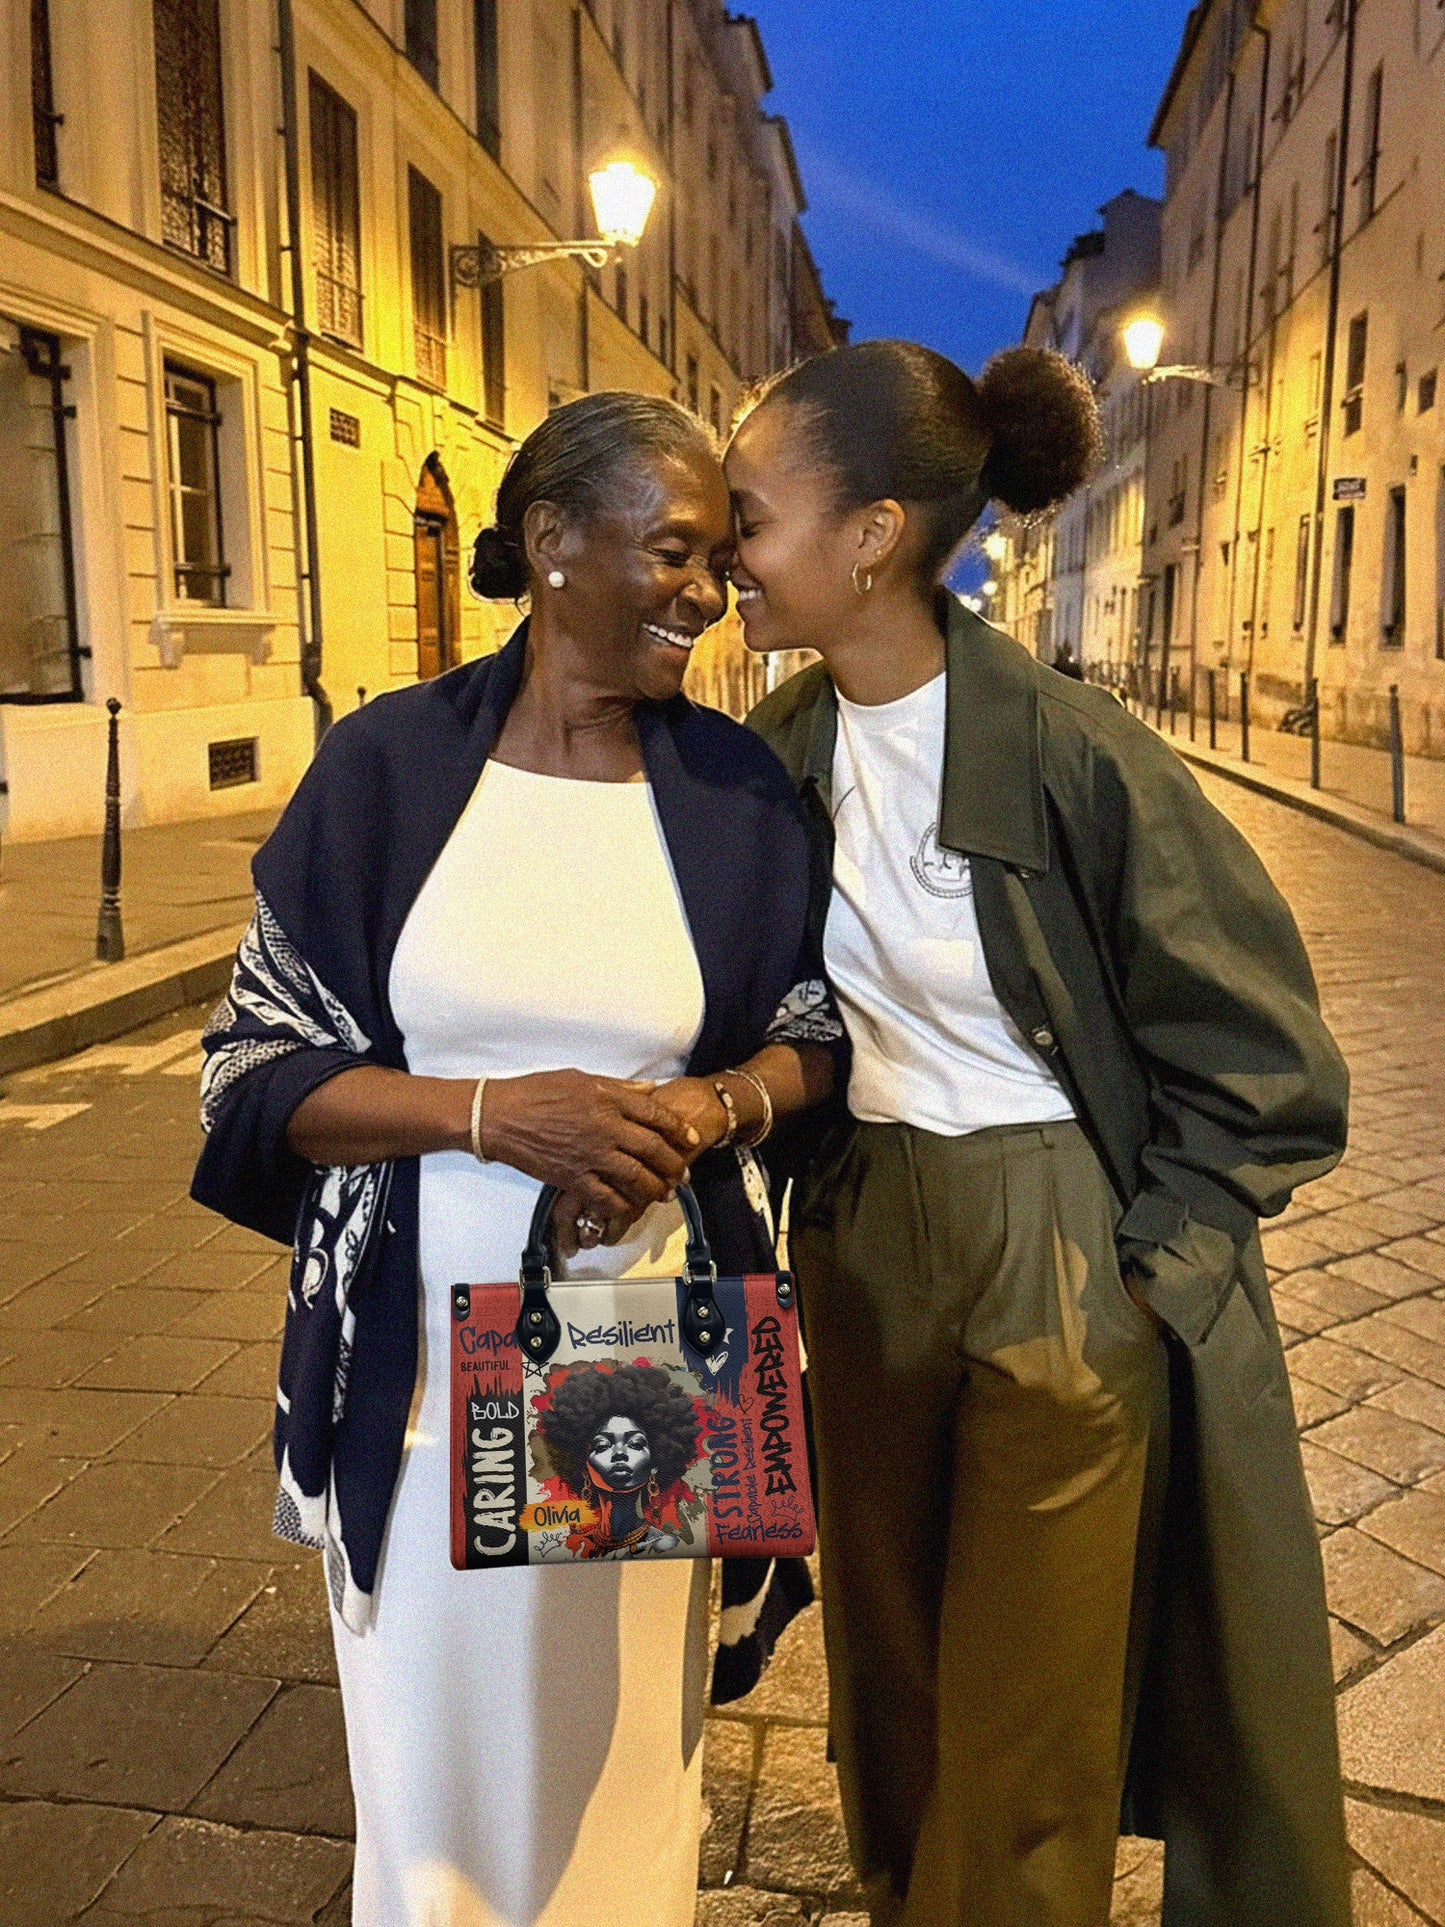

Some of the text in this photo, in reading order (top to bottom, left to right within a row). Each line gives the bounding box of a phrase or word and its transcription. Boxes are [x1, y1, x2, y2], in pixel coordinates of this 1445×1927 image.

[459, 1327, 519, 1356] Capa
[567, 1319, 675, 1349] Resilient
[461, 1360, 511, 1372] BEAUTIFUL
[471, 1401, 519, 1420] BOLD
[752, 1316, 797, 1496] EMPOWERED
[708, 1417, 743, 1518] STRONG
[472, 1427, 516, 1556] CARING
[534, 1506, 580, 1526] Olivia
[715, 1521, 803, 1544] Fearless
